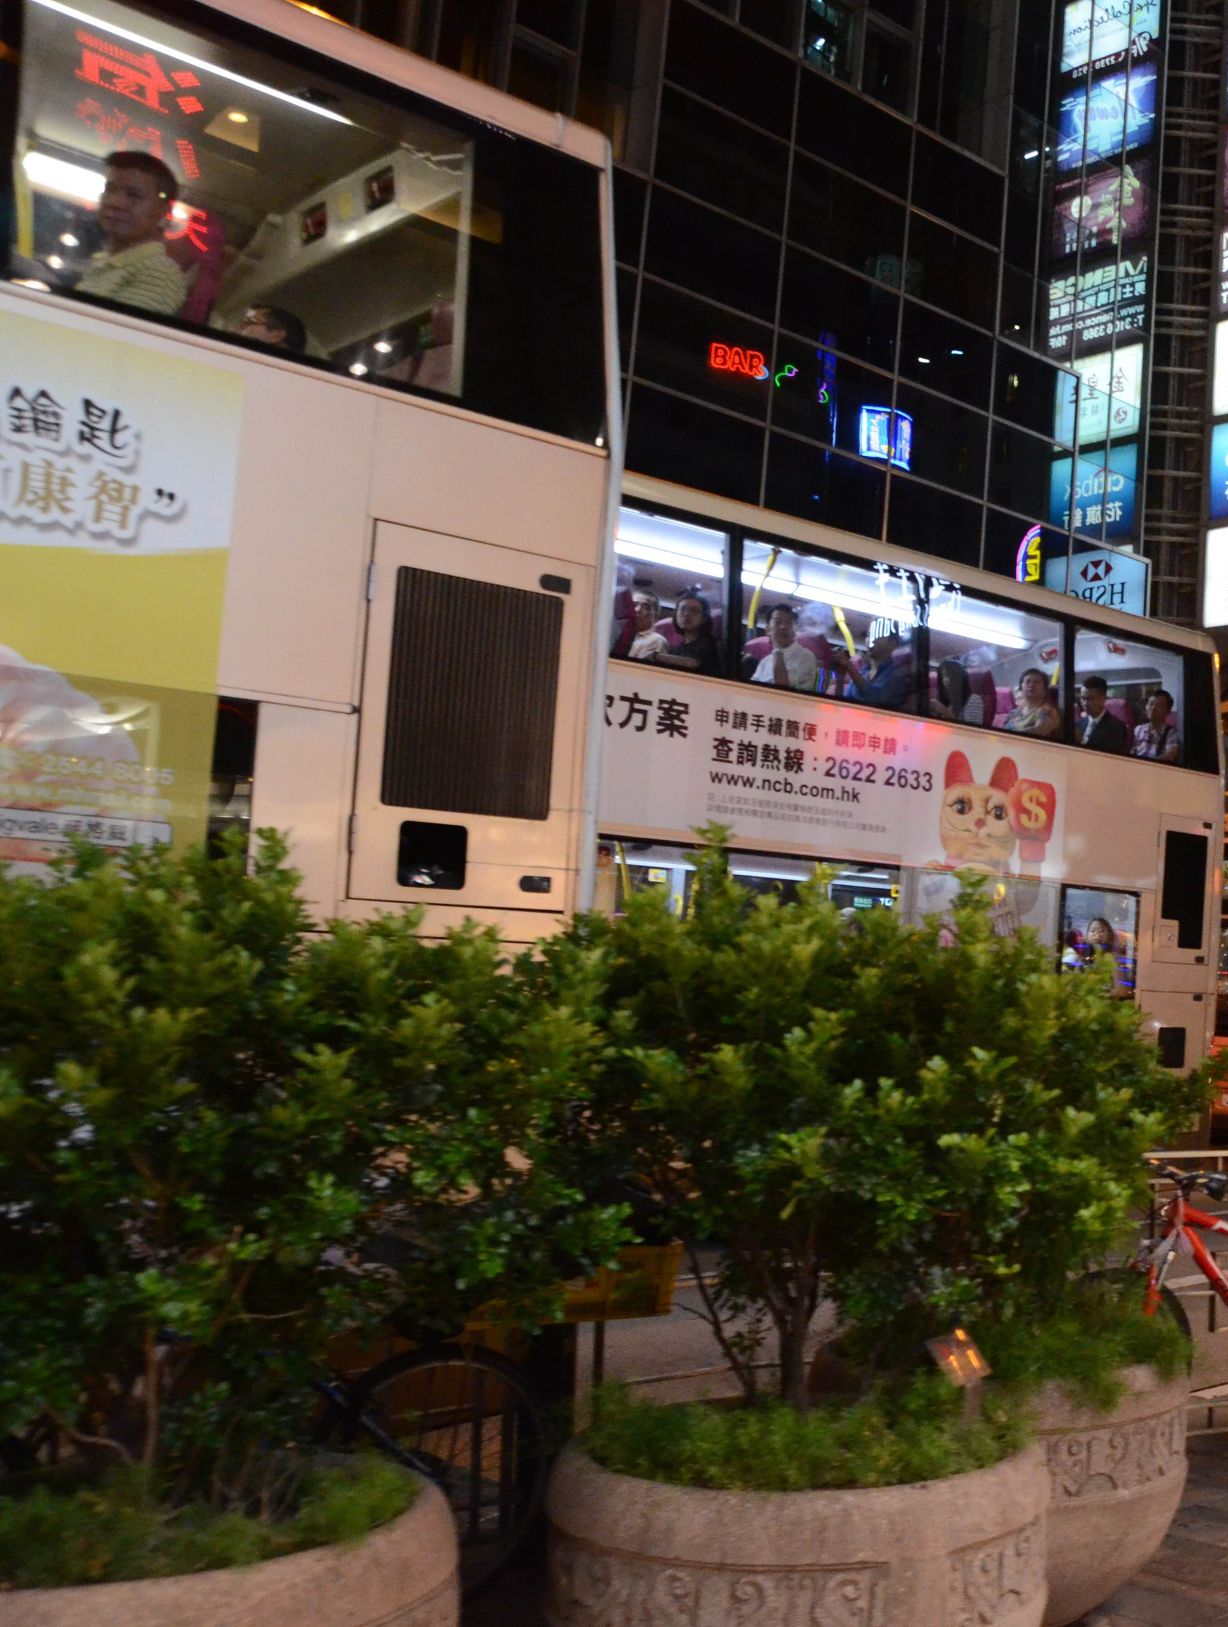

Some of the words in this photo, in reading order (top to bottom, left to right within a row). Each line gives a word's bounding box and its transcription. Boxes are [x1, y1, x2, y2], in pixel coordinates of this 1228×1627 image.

[710, 342, 765, 377] BAR
[6, 386, 131, 459] 鑰匙
[709, 769, 861, 804] www.ncb.com.hk
[883, 766, 934, 793] 2633
